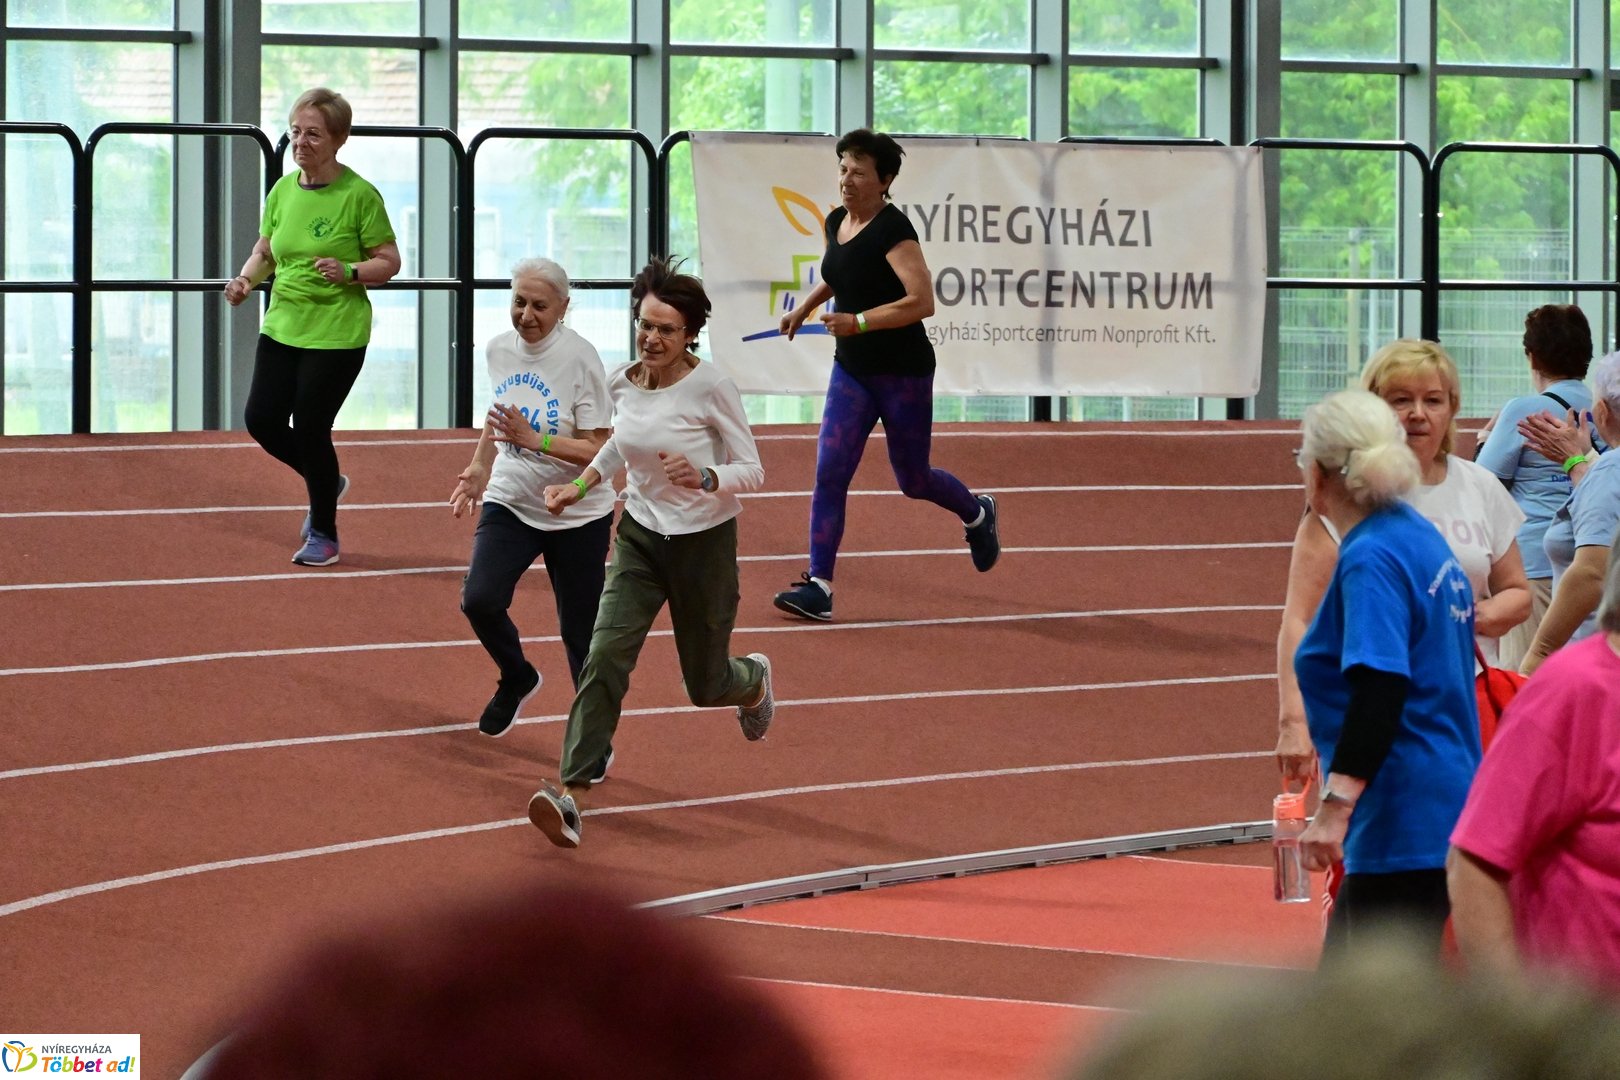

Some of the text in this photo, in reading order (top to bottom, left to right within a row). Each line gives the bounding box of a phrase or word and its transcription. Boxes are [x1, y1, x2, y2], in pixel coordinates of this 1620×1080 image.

[902, 193, 1152, 247] YÍREGYHÁZI
[935, 266, 1213, 310] ORTCENTRUM
[983, 322, 1097, 346] Sportcentrum
[1102, 324, 1180, 348] Nonprofit
[1185, 325, 1217, 344] Kft.
[495, 371, 551, 398] Nyugdíjas
[546, 398, 560, 436] Egye
